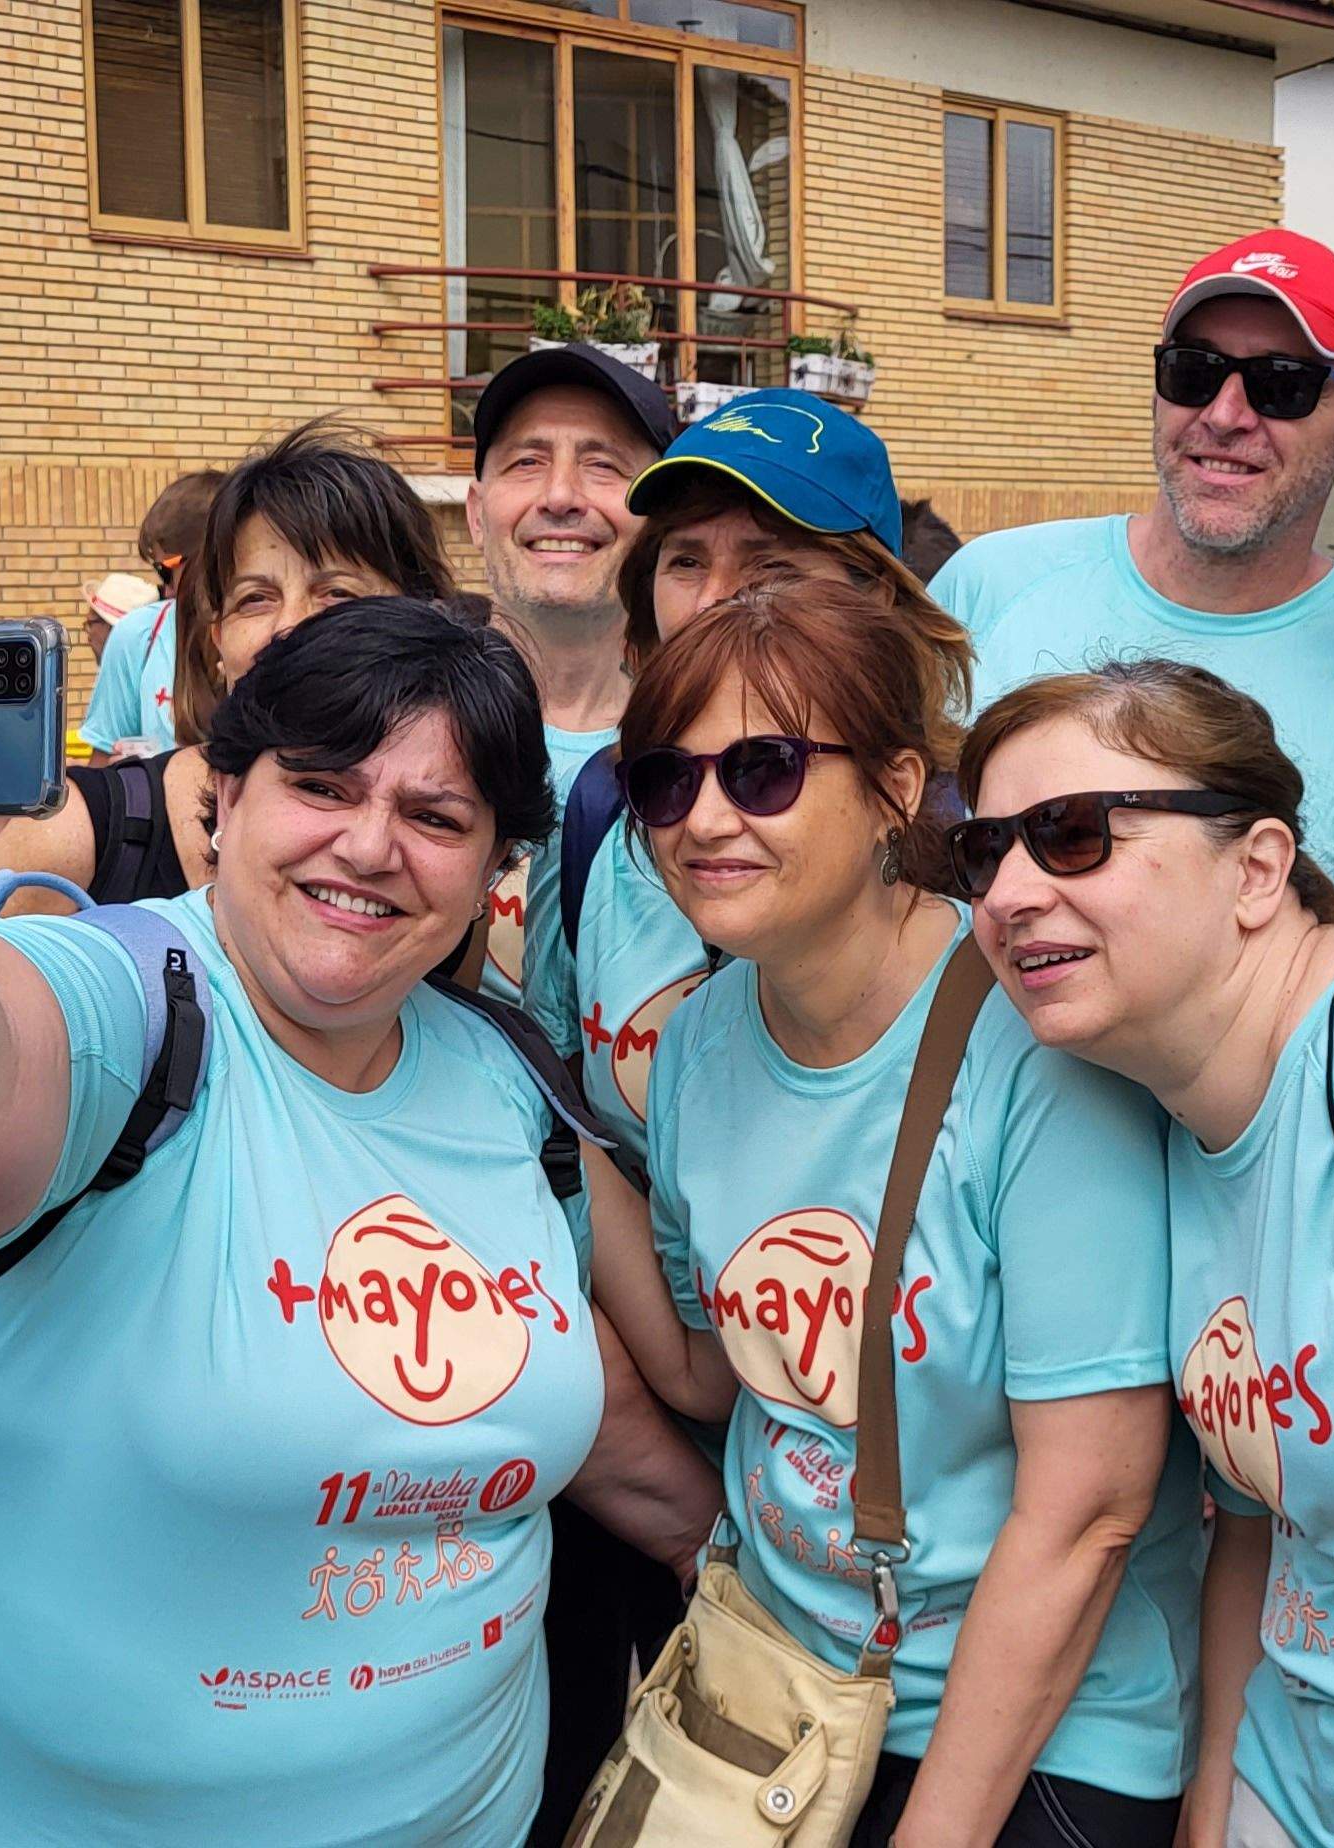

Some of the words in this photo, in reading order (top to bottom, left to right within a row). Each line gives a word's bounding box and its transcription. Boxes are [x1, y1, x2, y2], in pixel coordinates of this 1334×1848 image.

[380, 1467, 480, 1503] Marcha
[373, 1503, 420, 1518] ASPACE
[424, 1497, 470, 1513] HUESCA
[230, 1668, 332, 1692] ASPACE
[377, 1662, 411, 1680] hoya
